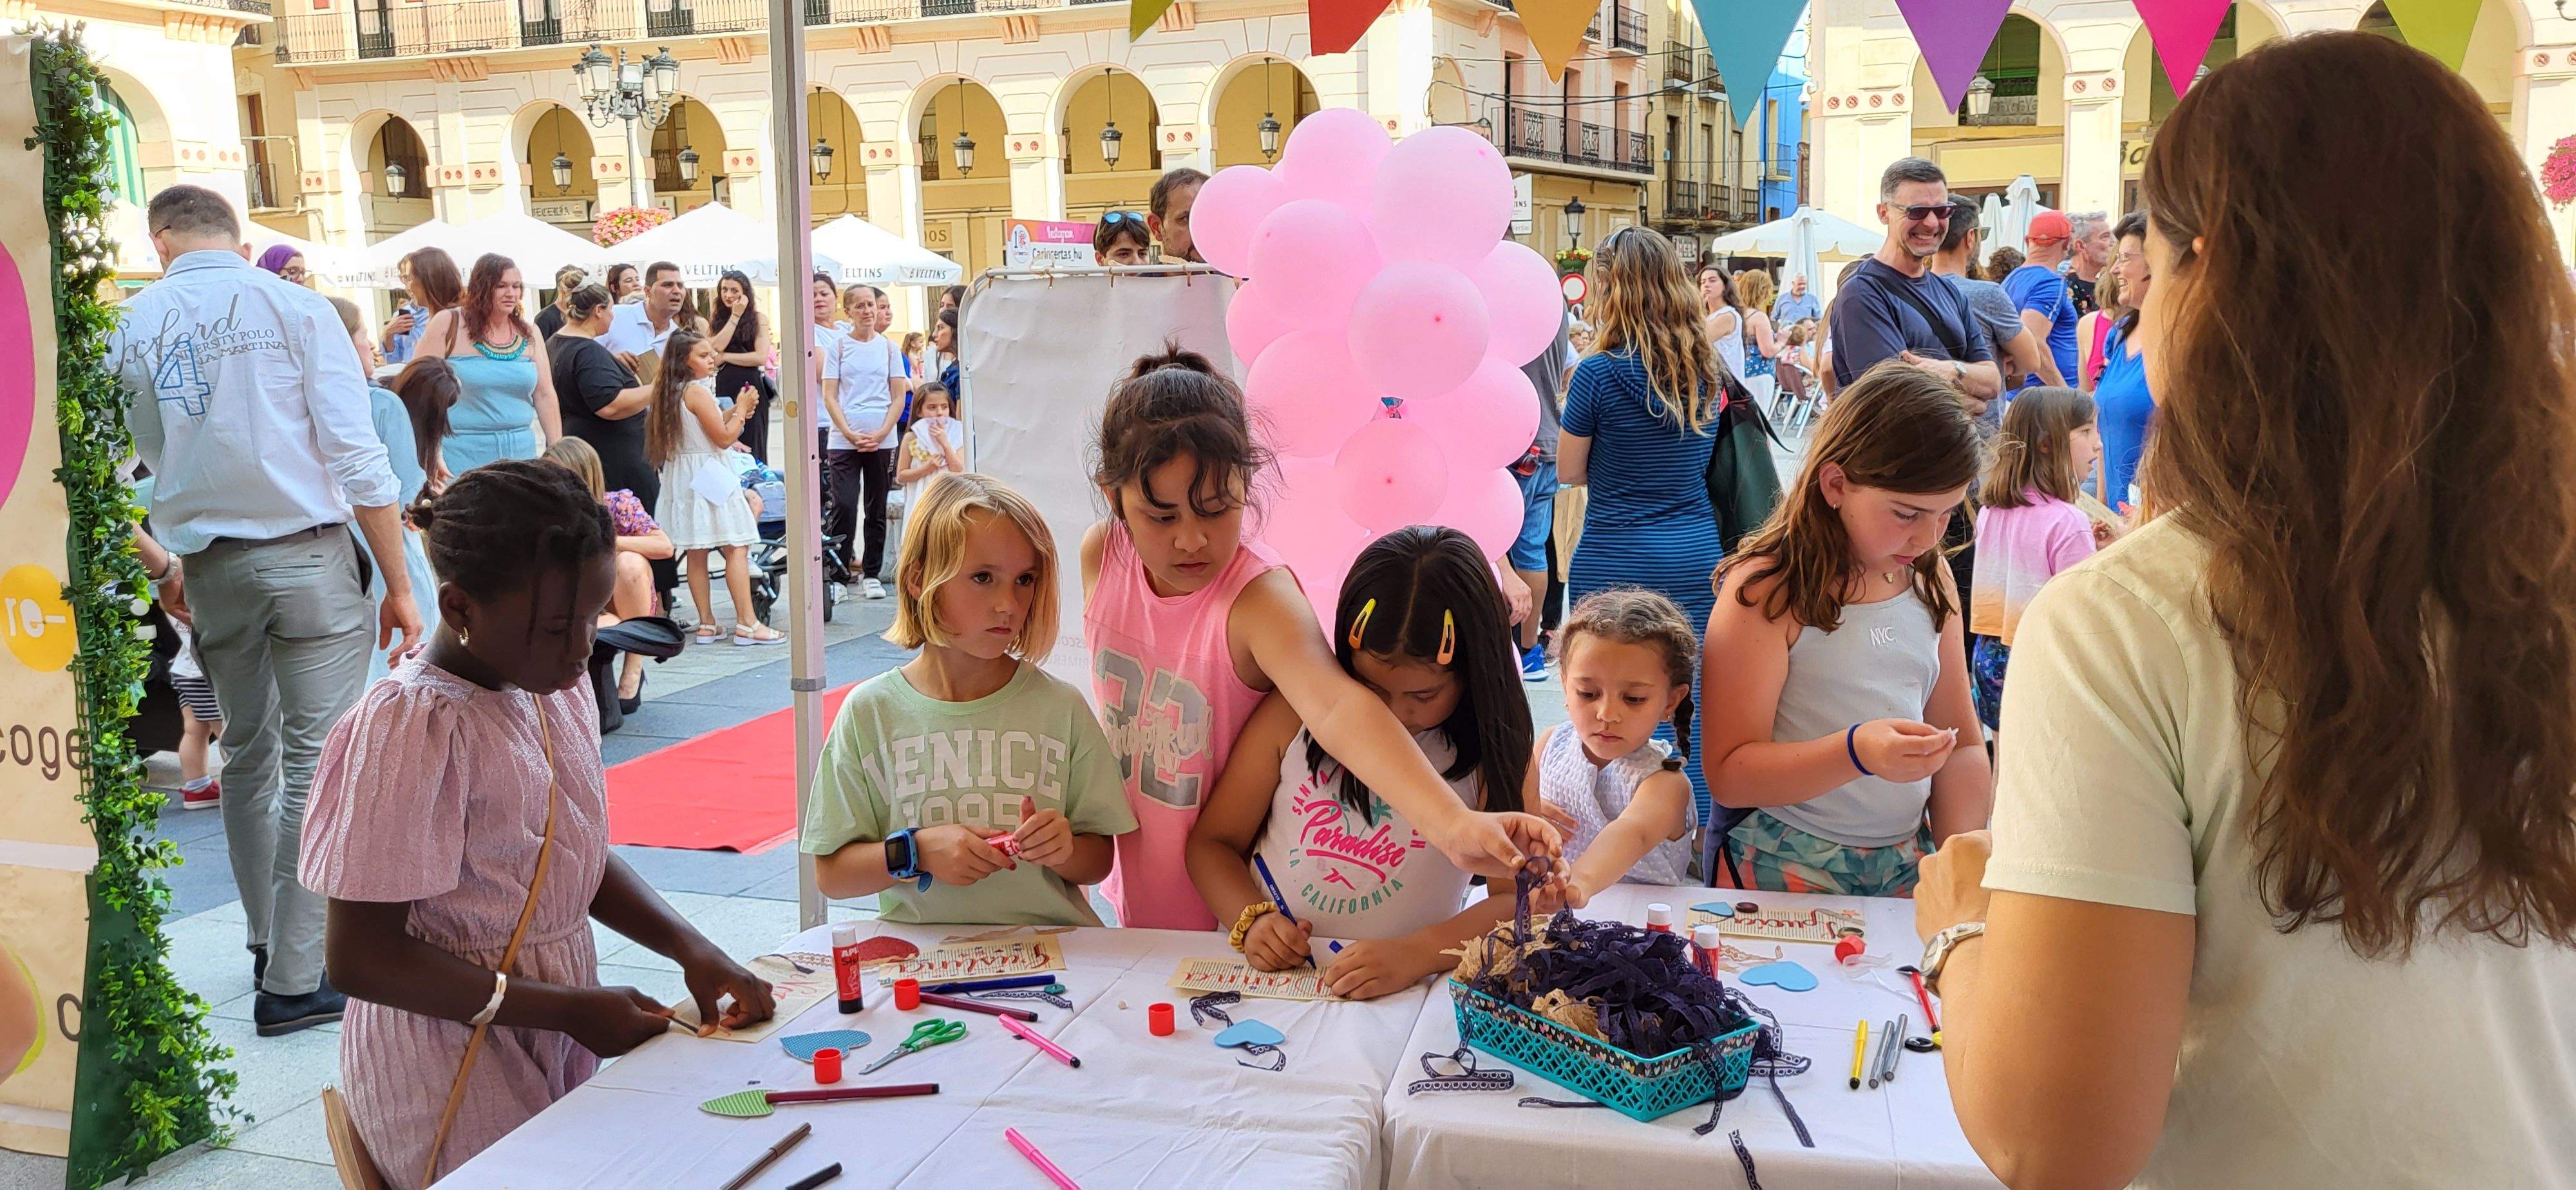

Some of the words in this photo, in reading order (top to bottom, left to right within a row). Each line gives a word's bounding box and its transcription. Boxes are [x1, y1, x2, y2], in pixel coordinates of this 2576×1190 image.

[924, 229, 947, 242] OS
[845, 267, 883, 278] ELTINS
[239, 328, 274, 341] POLO
[220, 341, 289, 356] MARTINA
[5, 598, 67, 638] re-
[1870, 626, 1895, 647] NYC
[861, 730, 1066, 806] VENICE
[1300, 799, 1406, 868] Paradise
[1301, 878, 1404, 914] CALIFORNIA
